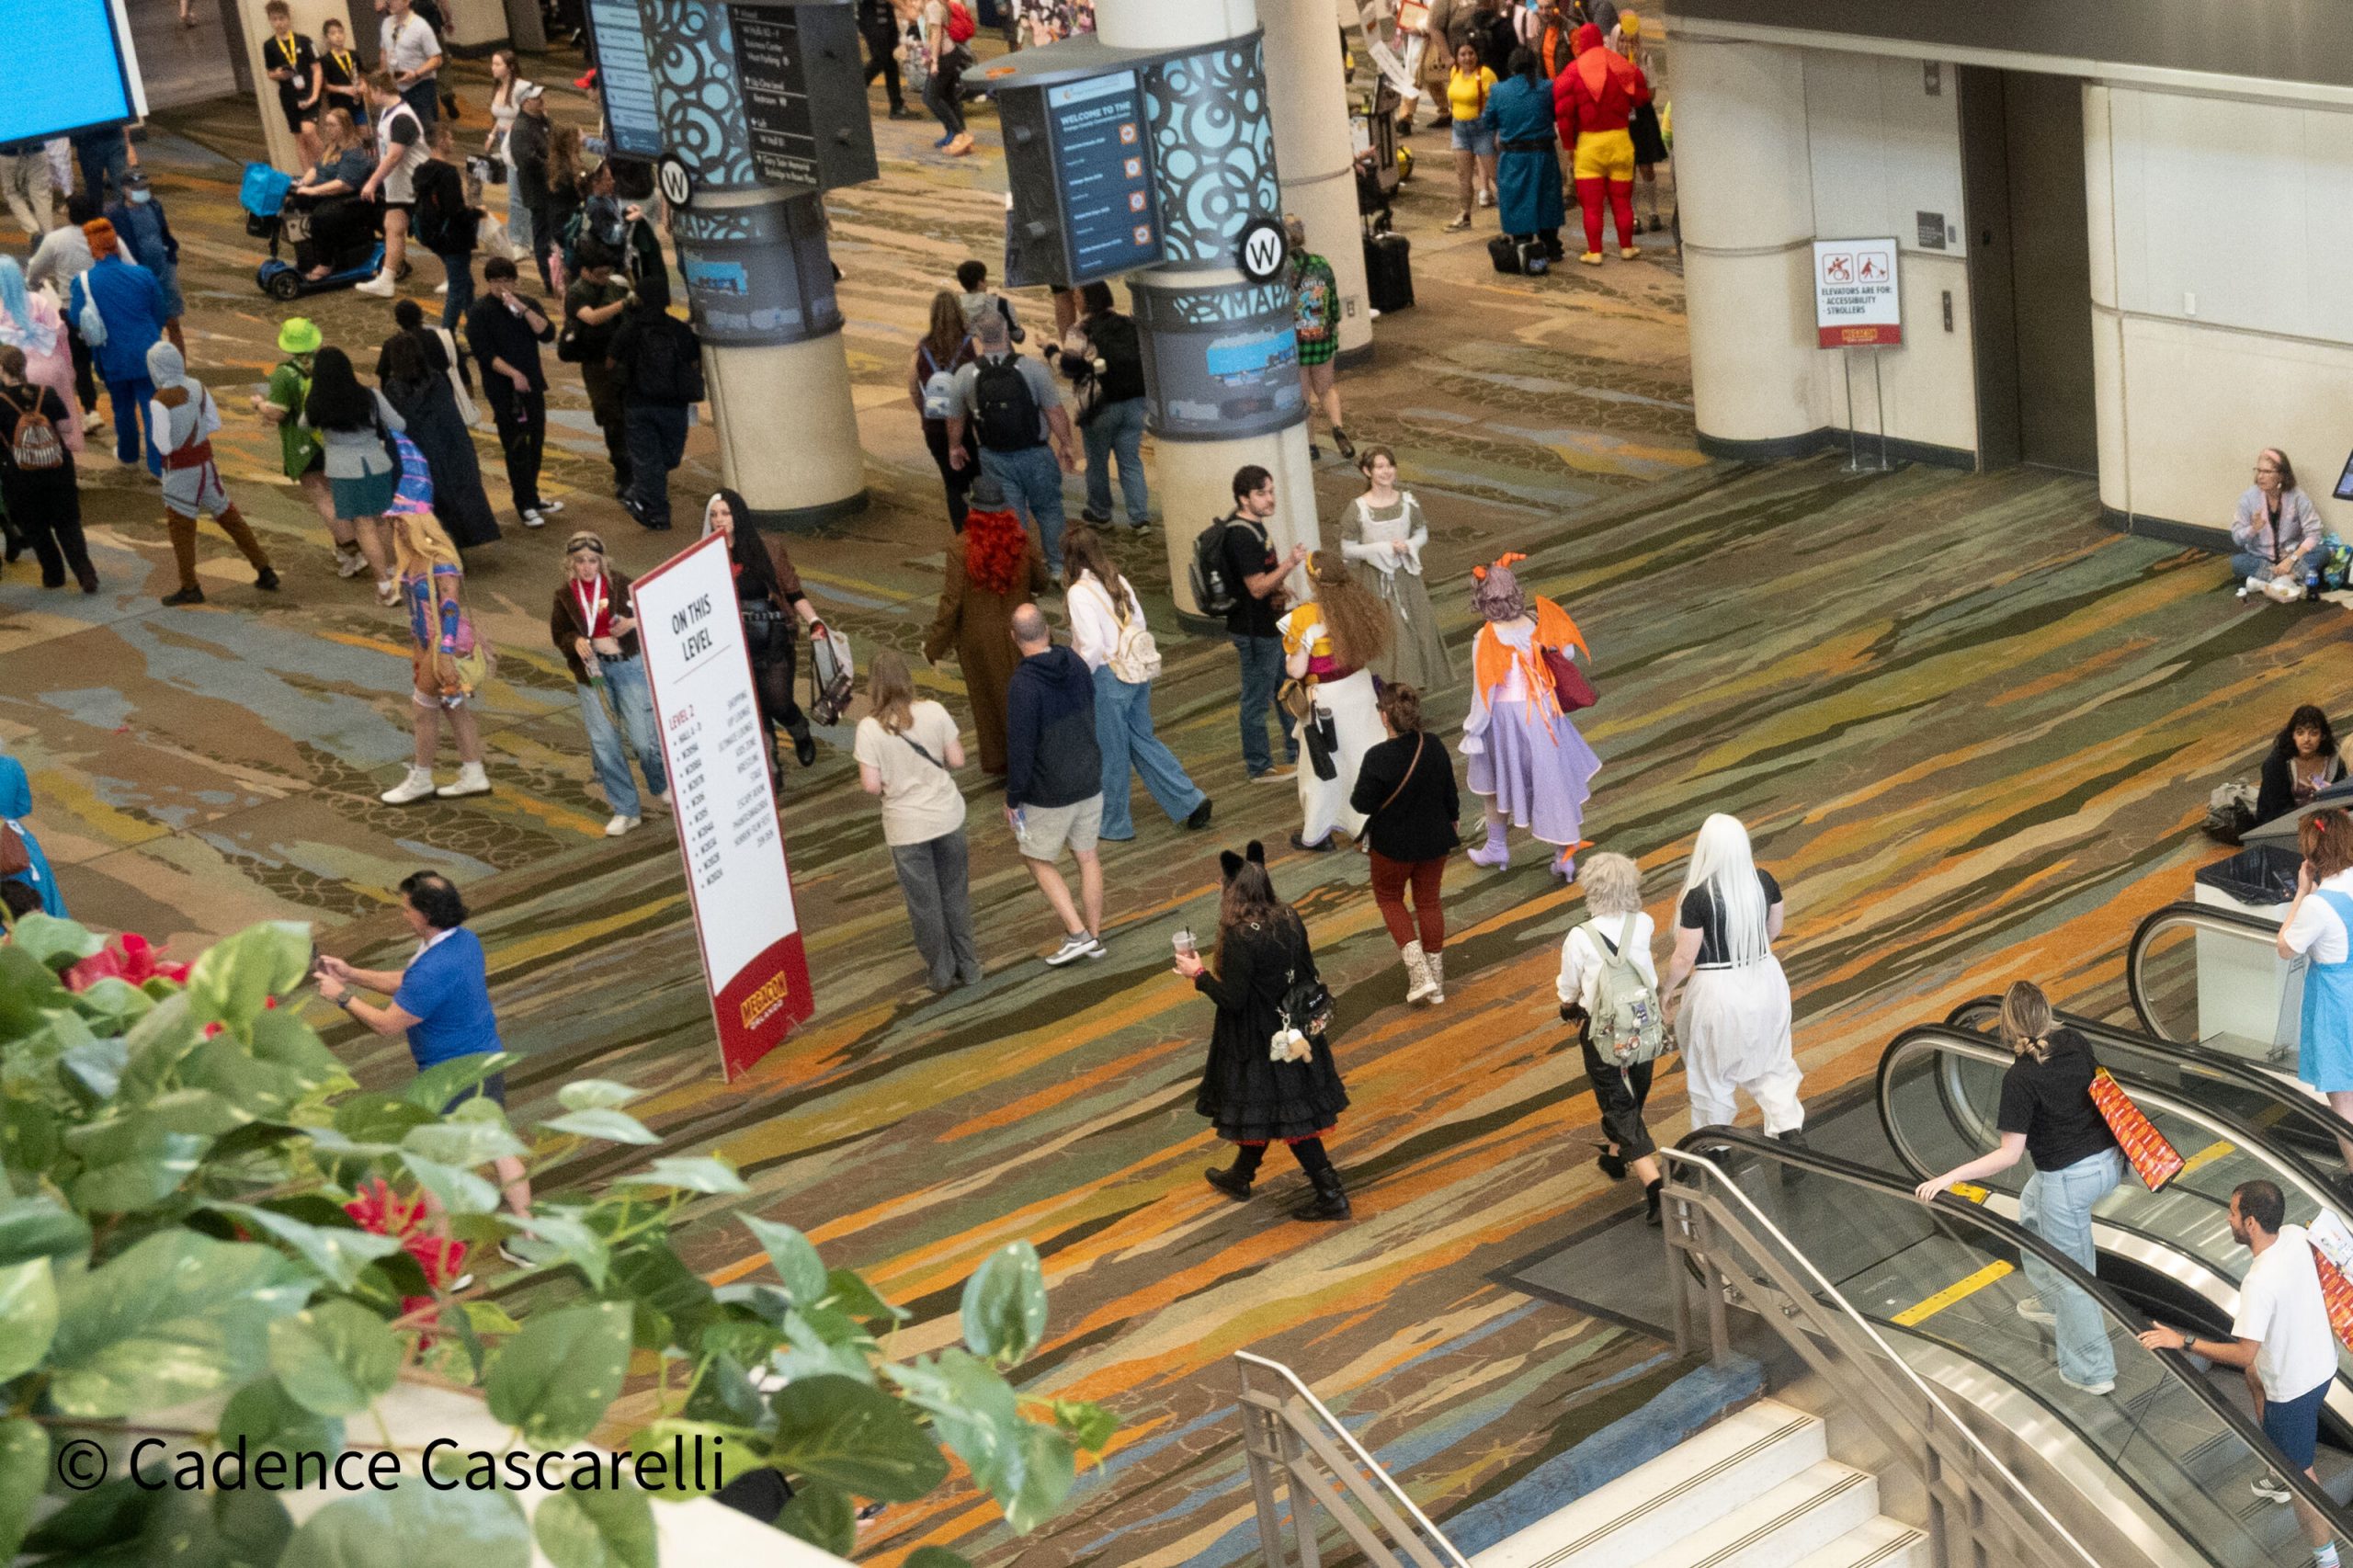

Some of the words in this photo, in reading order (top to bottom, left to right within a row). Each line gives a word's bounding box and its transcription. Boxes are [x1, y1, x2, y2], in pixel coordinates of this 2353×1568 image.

[1060, 108, 1102, 126] WELCOME
[1102, 105, 1115, 116] TO
[1114, 101, 1131, 112] THE
[665, 170, 684, 199] W
[1249, 235, 1275, 269] W
[1230, 283, 1283, 319] MAP
[1821, 287, 1859, 296] ELEVATORS
[1861, 286, 1874, 295] ARE
[1826, 296, 1877, 305] ACCESSIBILITY
[1826, 305, 1866, 315] STROLLERS
[672, 608, 688, 636] ON
[688, 593, 711, 624] THIS
[682, 627, 712, 662] LEVEL
[668, 709, 688, 731] LEVEL
[688, 704, 695, 717] 2
